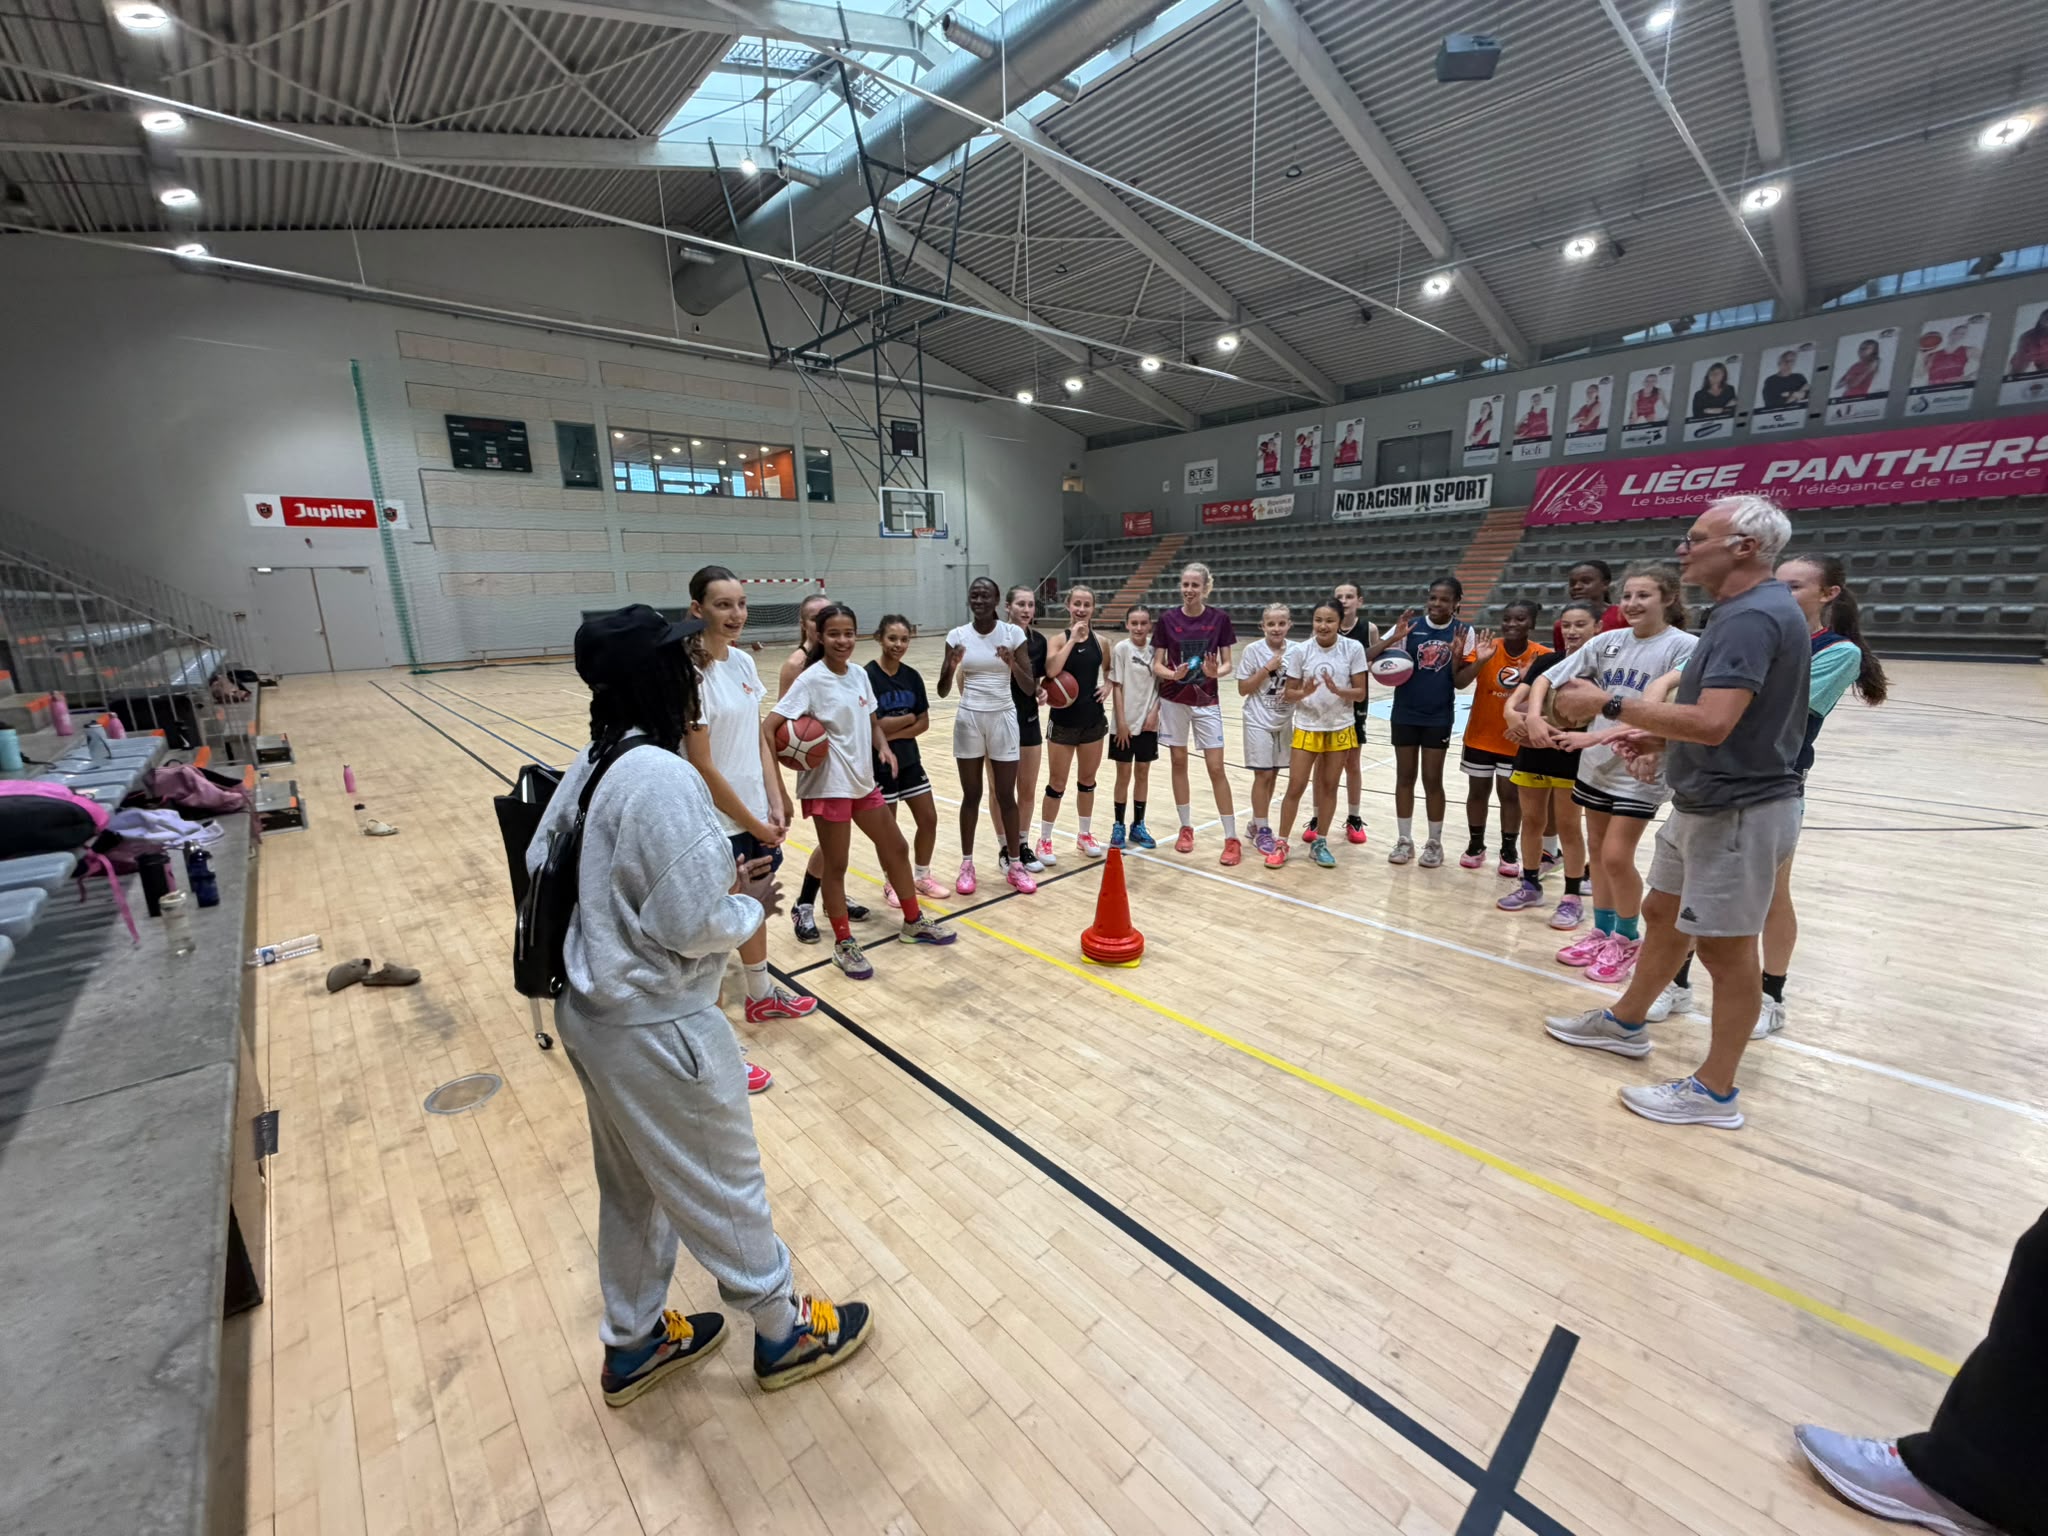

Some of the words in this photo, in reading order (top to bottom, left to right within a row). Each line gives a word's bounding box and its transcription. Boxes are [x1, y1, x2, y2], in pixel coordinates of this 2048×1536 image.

[1335, 493, 1355, 512] NO
[1355, 486, 1412, 511] RACISM
[1415, 484, 1432, 505] IN
[1433, 478, 1488, 503] SPORT
[1618, 463, 1746, 496] LIÈGE
[1631, 497, 1650, 507] Le
[1654, 492, 1712, 506] basket
[1798, 480, 1904, 495] l'élégance
[1905, 475, 1941, 488] de
[1949, 473, 1968, 485] la
[1976, 467, 2041, 483] force
[294, 503, 366, 521] Jupiler
